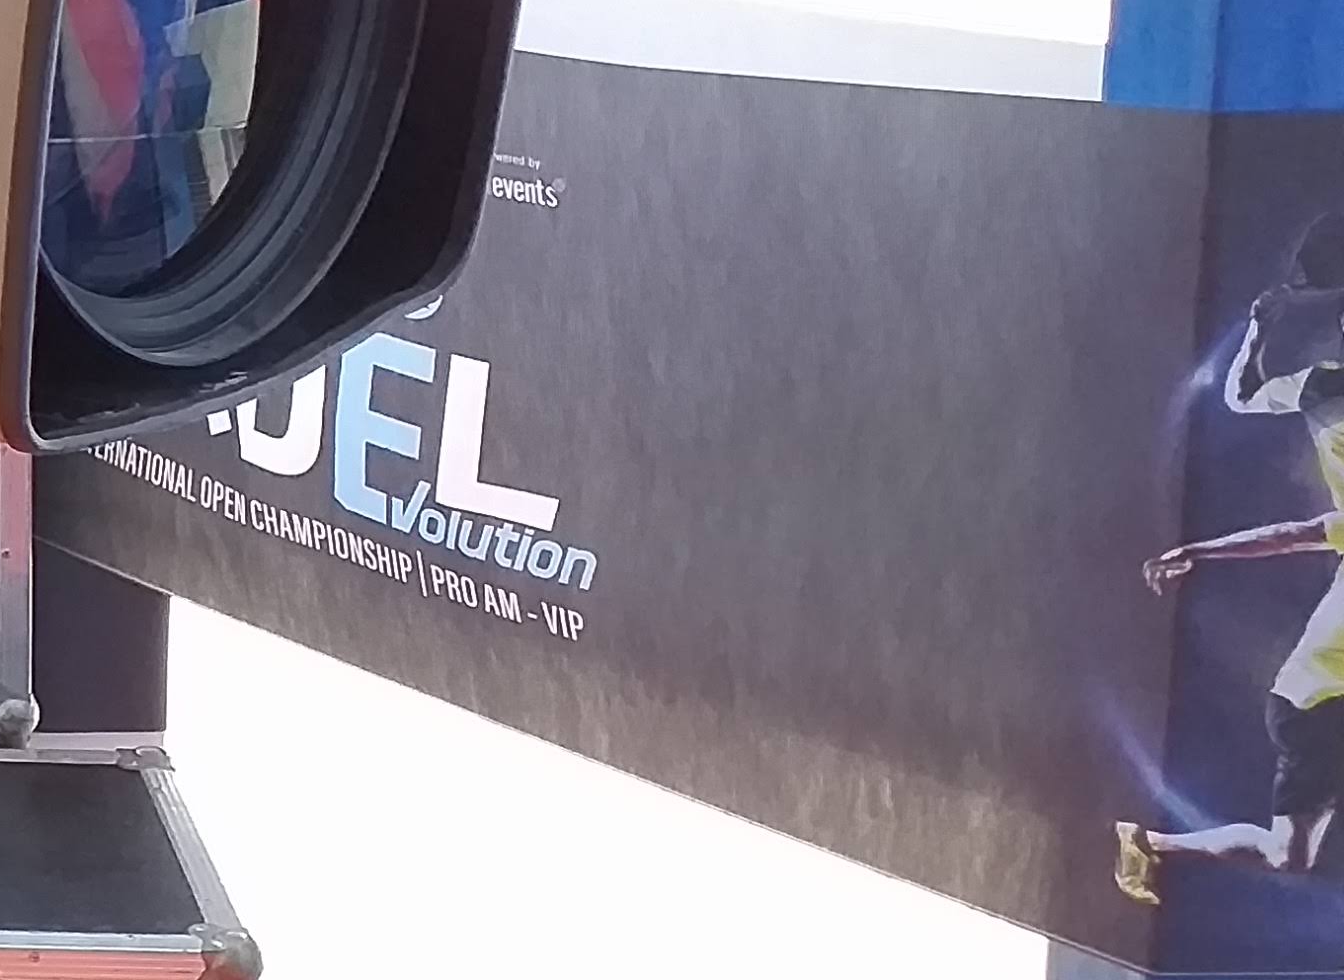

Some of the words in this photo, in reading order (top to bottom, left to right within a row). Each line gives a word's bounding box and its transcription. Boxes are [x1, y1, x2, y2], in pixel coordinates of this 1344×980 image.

[528, 156, 541, 171] by
[490, 176, 559, 208] events
[200, 475, 248, 526] OPEN
[249, 499, 414, 585] CHAMPIONSHIP
[431, 562, 479, 609] PRO
[483, 587, 522, 624] AM
[541, 602, 586, 642] VIP
